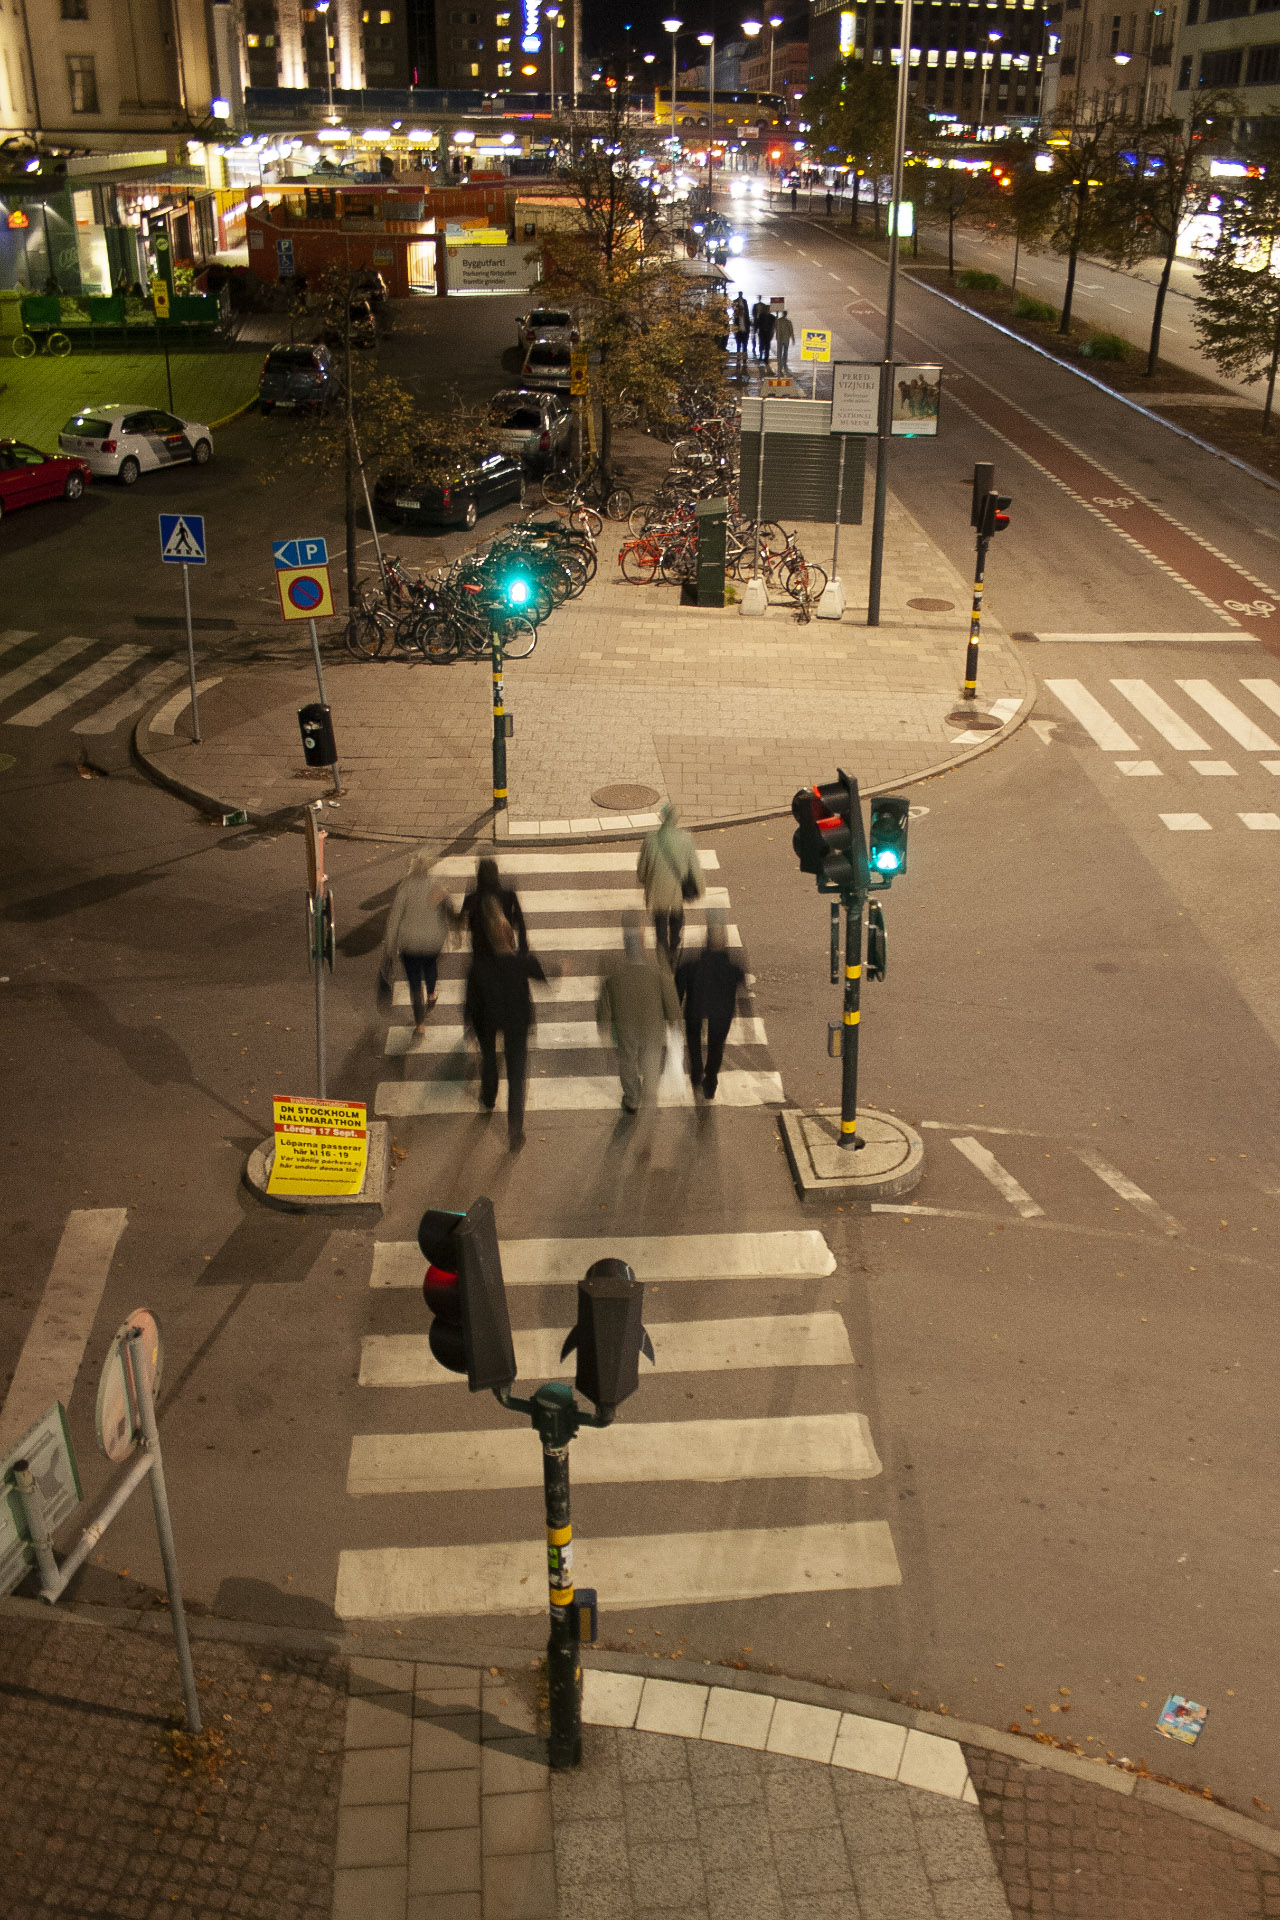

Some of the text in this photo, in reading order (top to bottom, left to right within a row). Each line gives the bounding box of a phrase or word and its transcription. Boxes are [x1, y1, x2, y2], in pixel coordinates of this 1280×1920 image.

[281, 241, 289, 253] P
[462, 259, 506, 269] Byggutfart!
[838, 381, 875, 391] VIZJNIKI
[306, 544, 318, 561] P
[280, 1106, 360, 1119] DN STOCKHOLM
[279, 1114, 362, 1128] HALVMARATHON
[283, 1124, 358, 1139] Lördag 17 Sept.
[280, 1139, 362, 1152] Löparna passerar
[293, 1148, 308, 1156] här
[320, 1150, 331, 1158] 16
[280, 1154, 295, 1162] Var
[296, 1156, 320, 1165] vänlig
[321, 1158, 352, 1166] parkera
